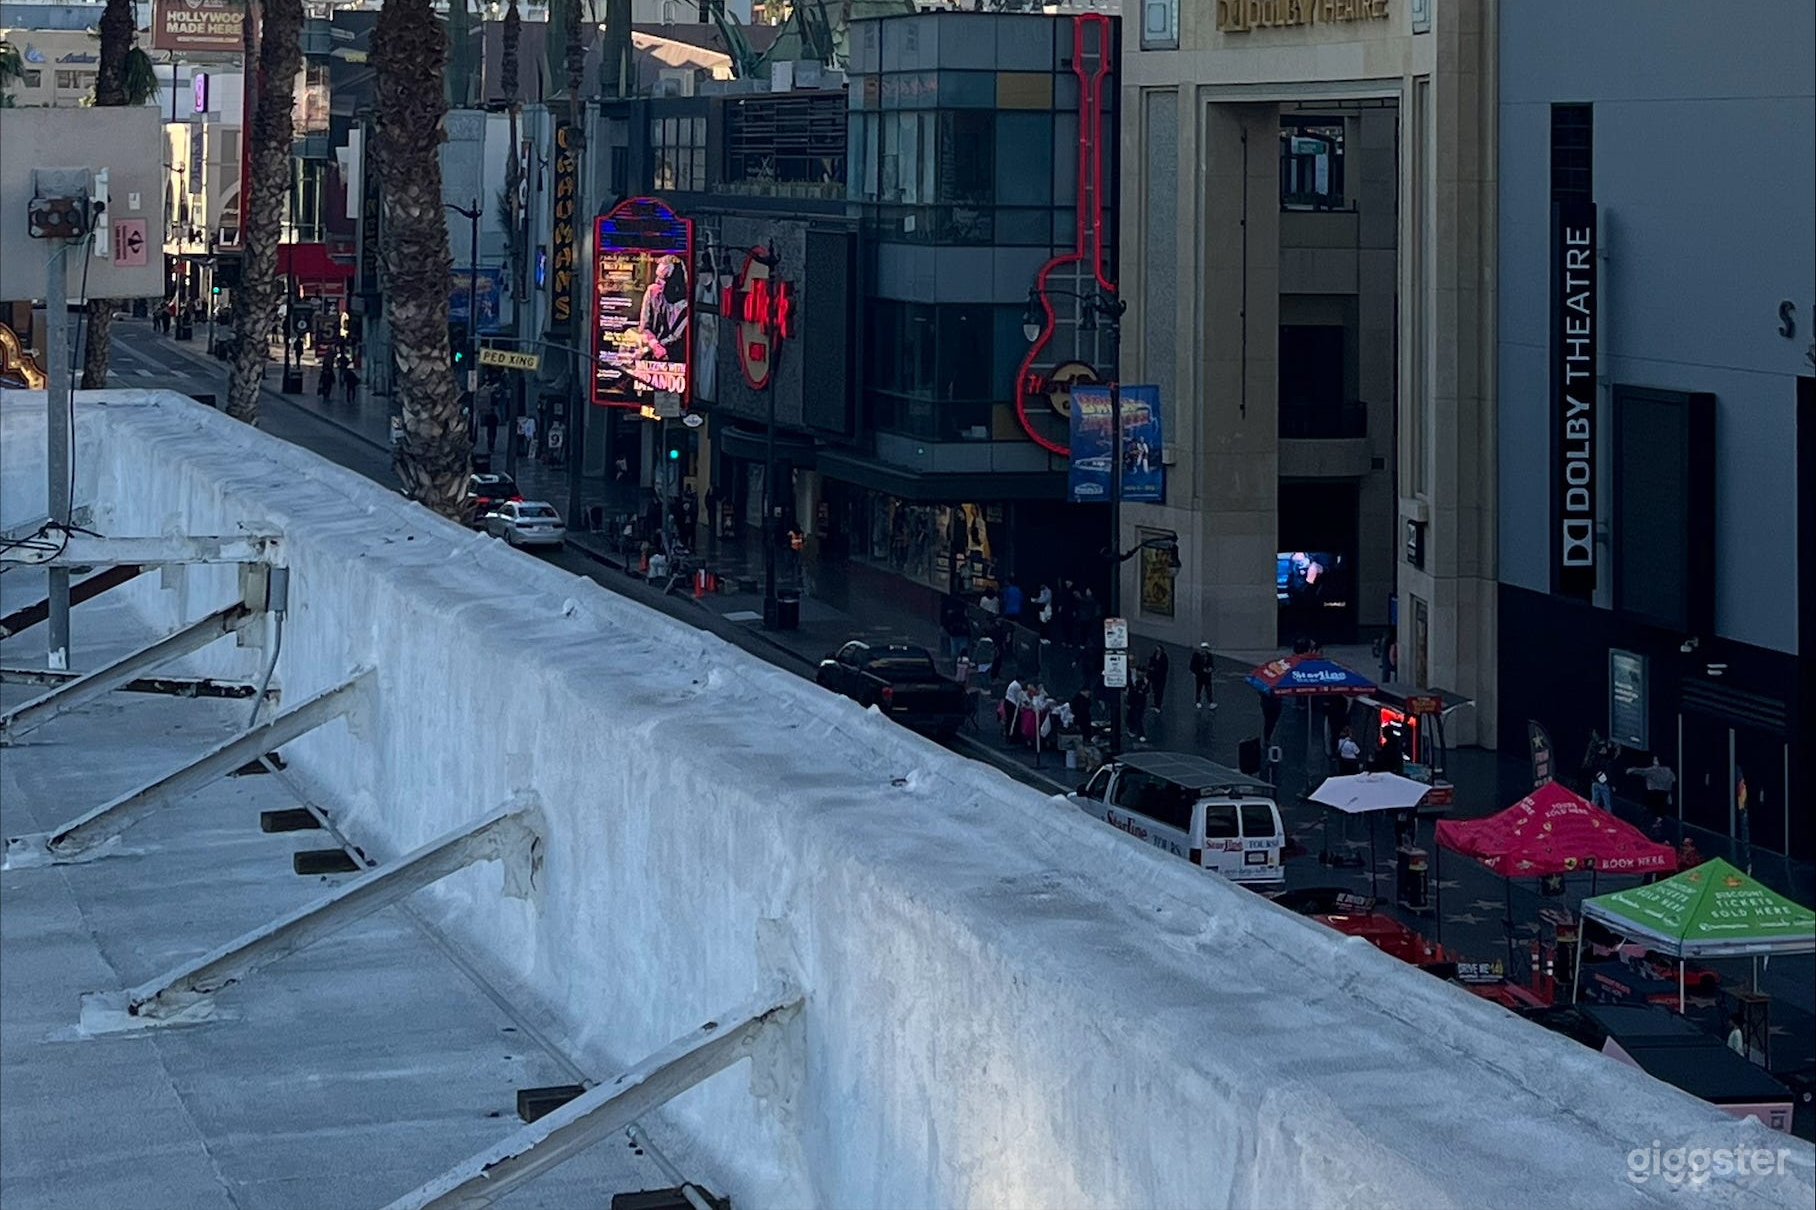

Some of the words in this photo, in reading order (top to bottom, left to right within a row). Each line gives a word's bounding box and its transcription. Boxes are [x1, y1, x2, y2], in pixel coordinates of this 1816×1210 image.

[166, 11, 245, 23] HOLLYWOO
[166, 22, 204, 33] MADE
[207, 24, 241, 35] HERE
[1565, 227, 1591, 386] THEATRE
[483, 351, 506, 363] PED
[510, 355, 535, 367] XING
[1565, 394, 1590, 513] DOLBY
[1602, 858, 1634, 869] BOOK
[1638, 855, 1665, 866] HERE
[1716, 898, 1774, 908] TICKETS
[1711, 909, 1748, 919] SOLD
[1754, 906, 1792, 916] HERE
